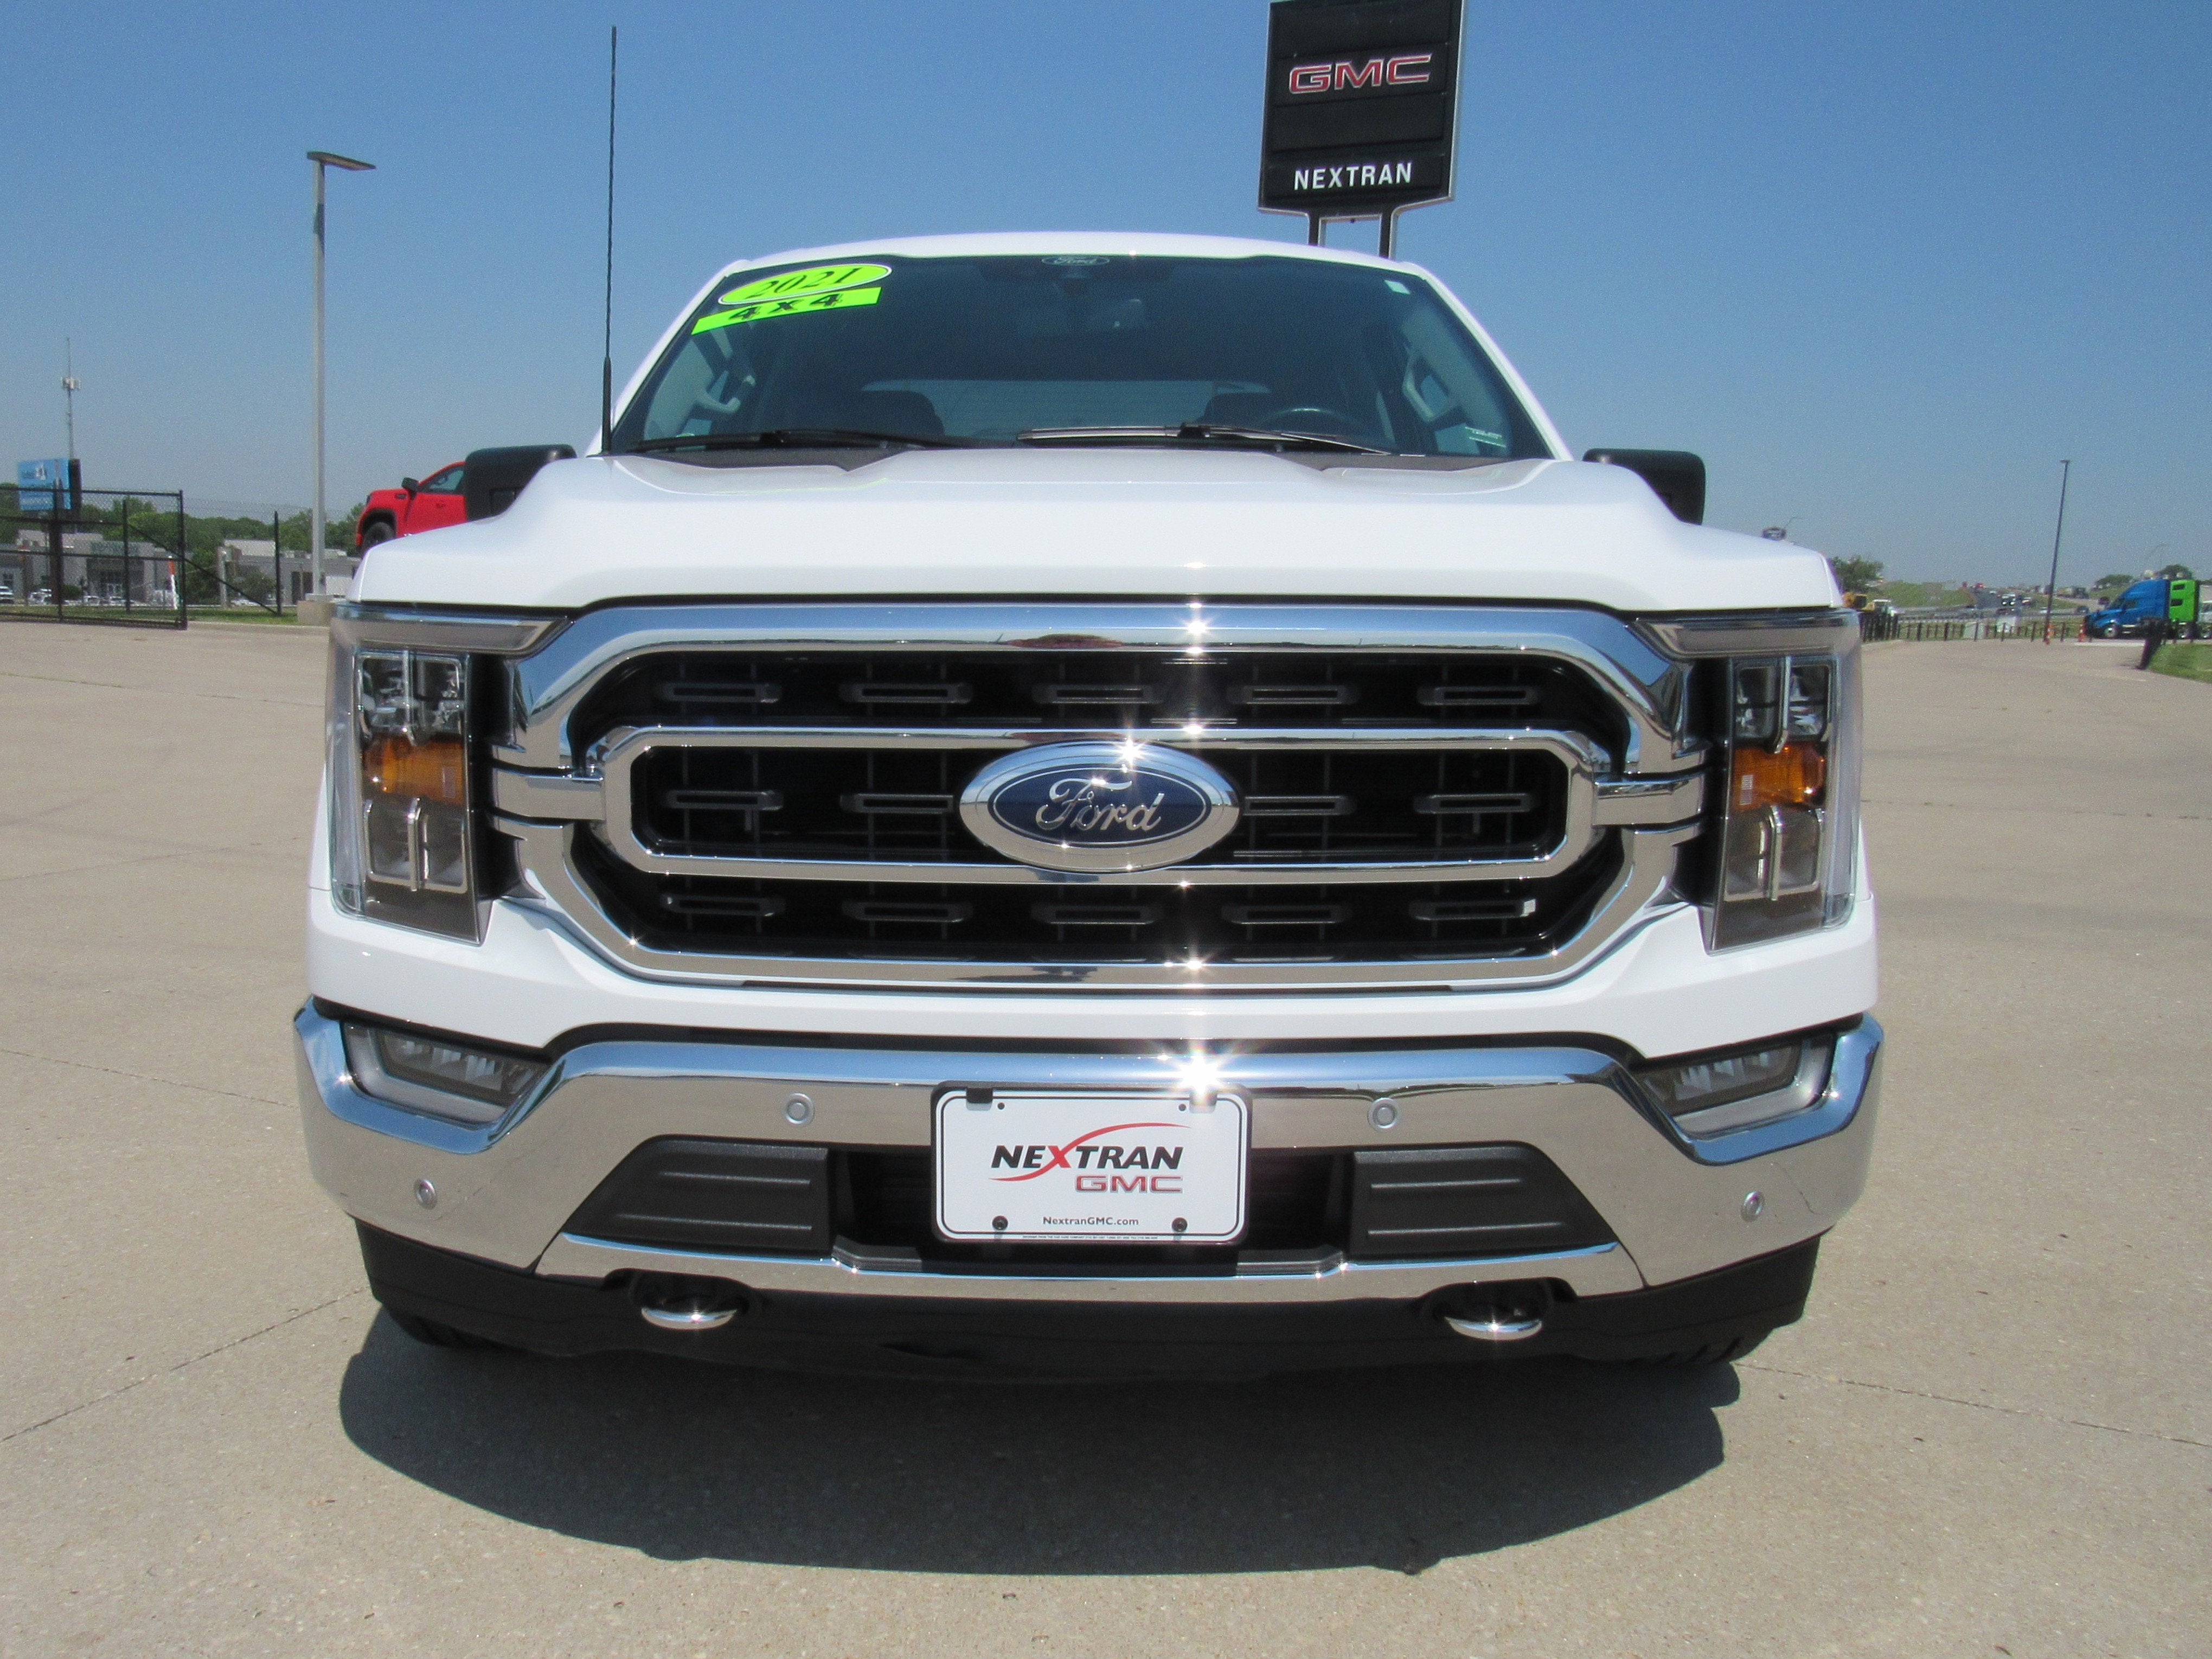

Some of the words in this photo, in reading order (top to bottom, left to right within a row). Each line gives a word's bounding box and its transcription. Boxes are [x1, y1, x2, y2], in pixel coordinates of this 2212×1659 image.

[1289, 53, 1432, 94] GMC
[1294, 162, 1412, 190] NEXTRAN
[745, 267, 862, 299] 2021
[1035, 777, 1164, 831] Ford
[991, 1145, 1184, 1170] NEXTRAN
[1075, 1174, 1183, 1193] GMC
[1042, 1216, 1139, 1226] NextranGMC.com
